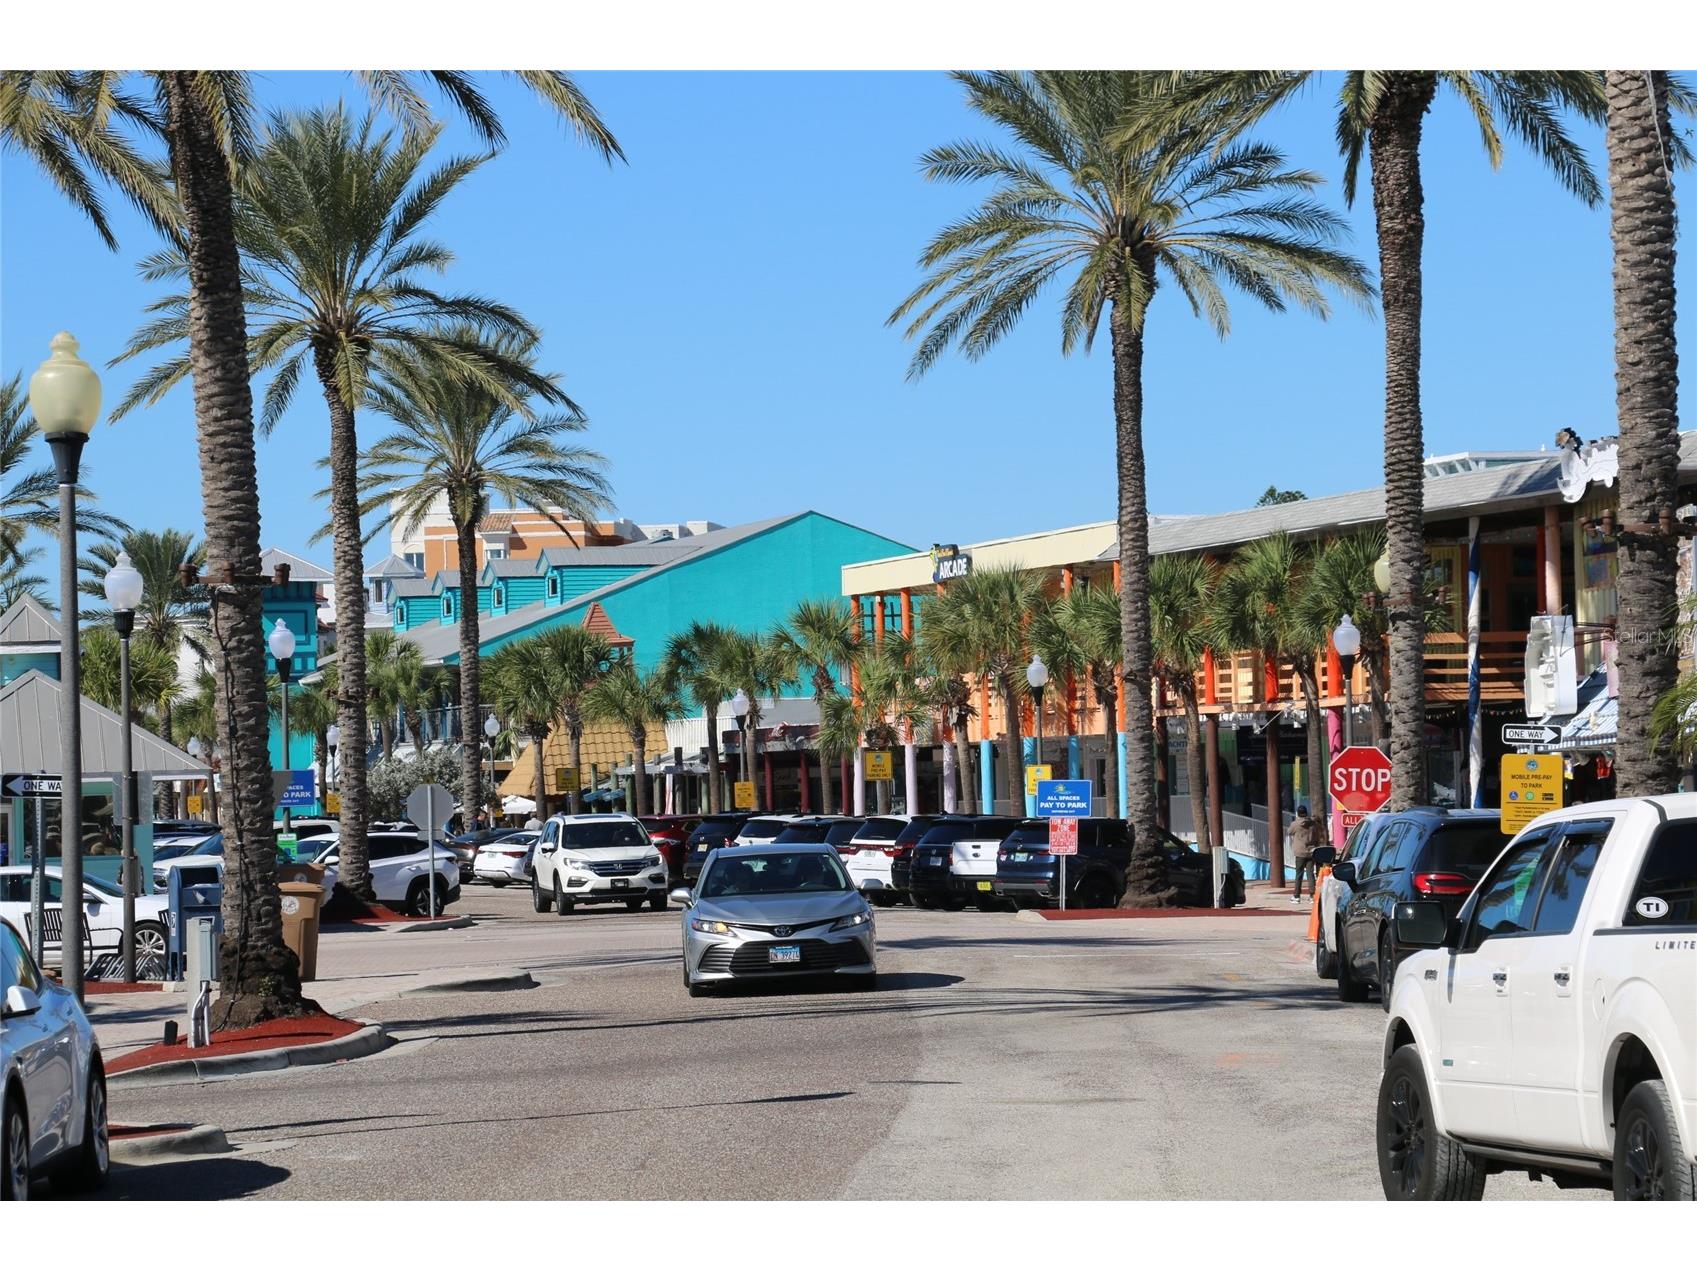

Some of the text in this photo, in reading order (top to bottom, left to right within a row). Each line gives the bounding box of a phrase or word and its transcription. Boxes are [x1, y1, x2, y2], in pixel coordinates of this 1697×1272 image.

[939, 557, 968, 580] ARCADE
[1508, 730, 1544, 739] ONE WAY
[1333, 767, 1392, 792] STOP
[23, 781, 62, 791] ONE WA
[1344, 816, 1358, 825] ALL
[1642, 902, 1660, 912] TI
[1655, 940, 1697, 950] LIMITE
